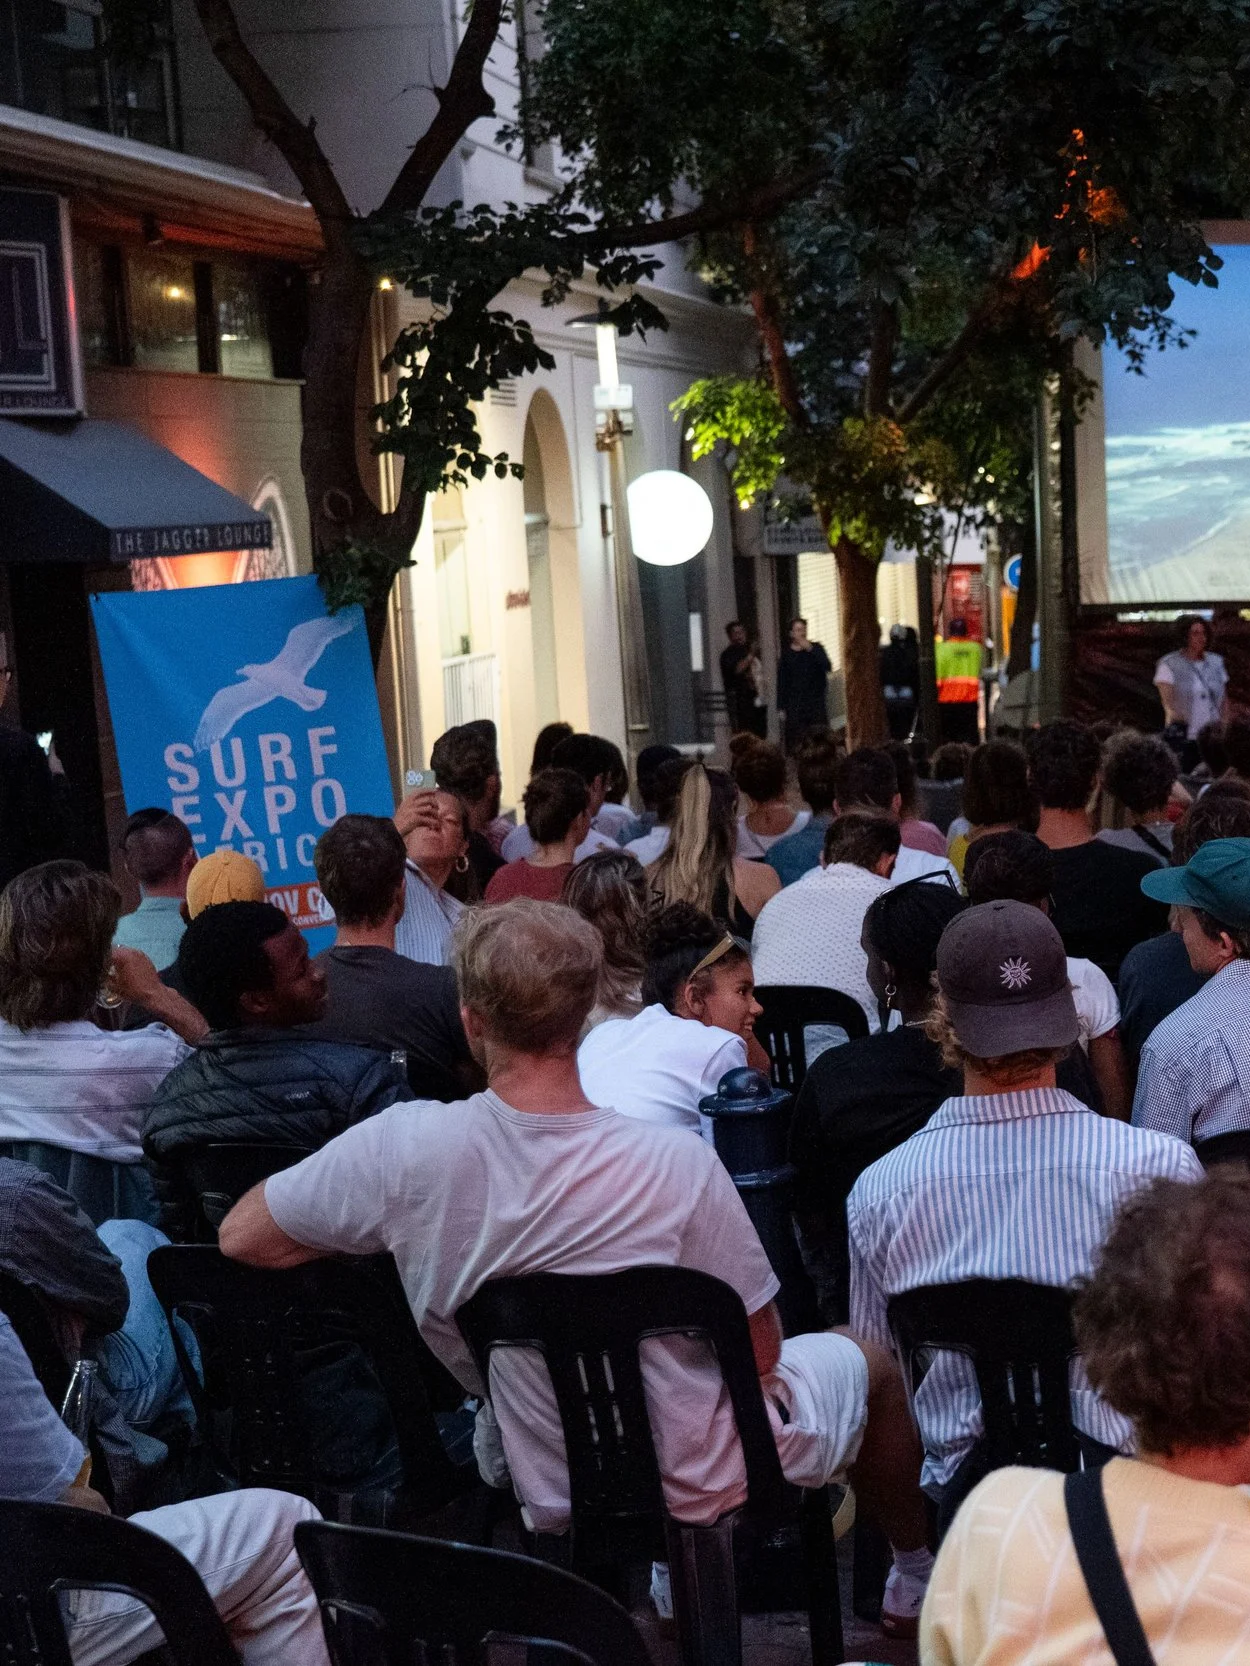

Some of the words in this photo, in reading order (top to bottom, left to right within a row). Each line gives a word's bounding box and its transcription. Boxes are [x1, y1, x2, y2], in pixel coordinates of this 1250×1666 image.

[116, 532, 143, 554] THE
[154, 528, 210, 550] JAGGER
[217, 523, 269, 547] LOUNGE
[164, 725, 338, 793] SURF
[171, 778, 348, 843] EXPO
[194, 833, 319, 873] RIC
[264, 888, 299, 916] OV
